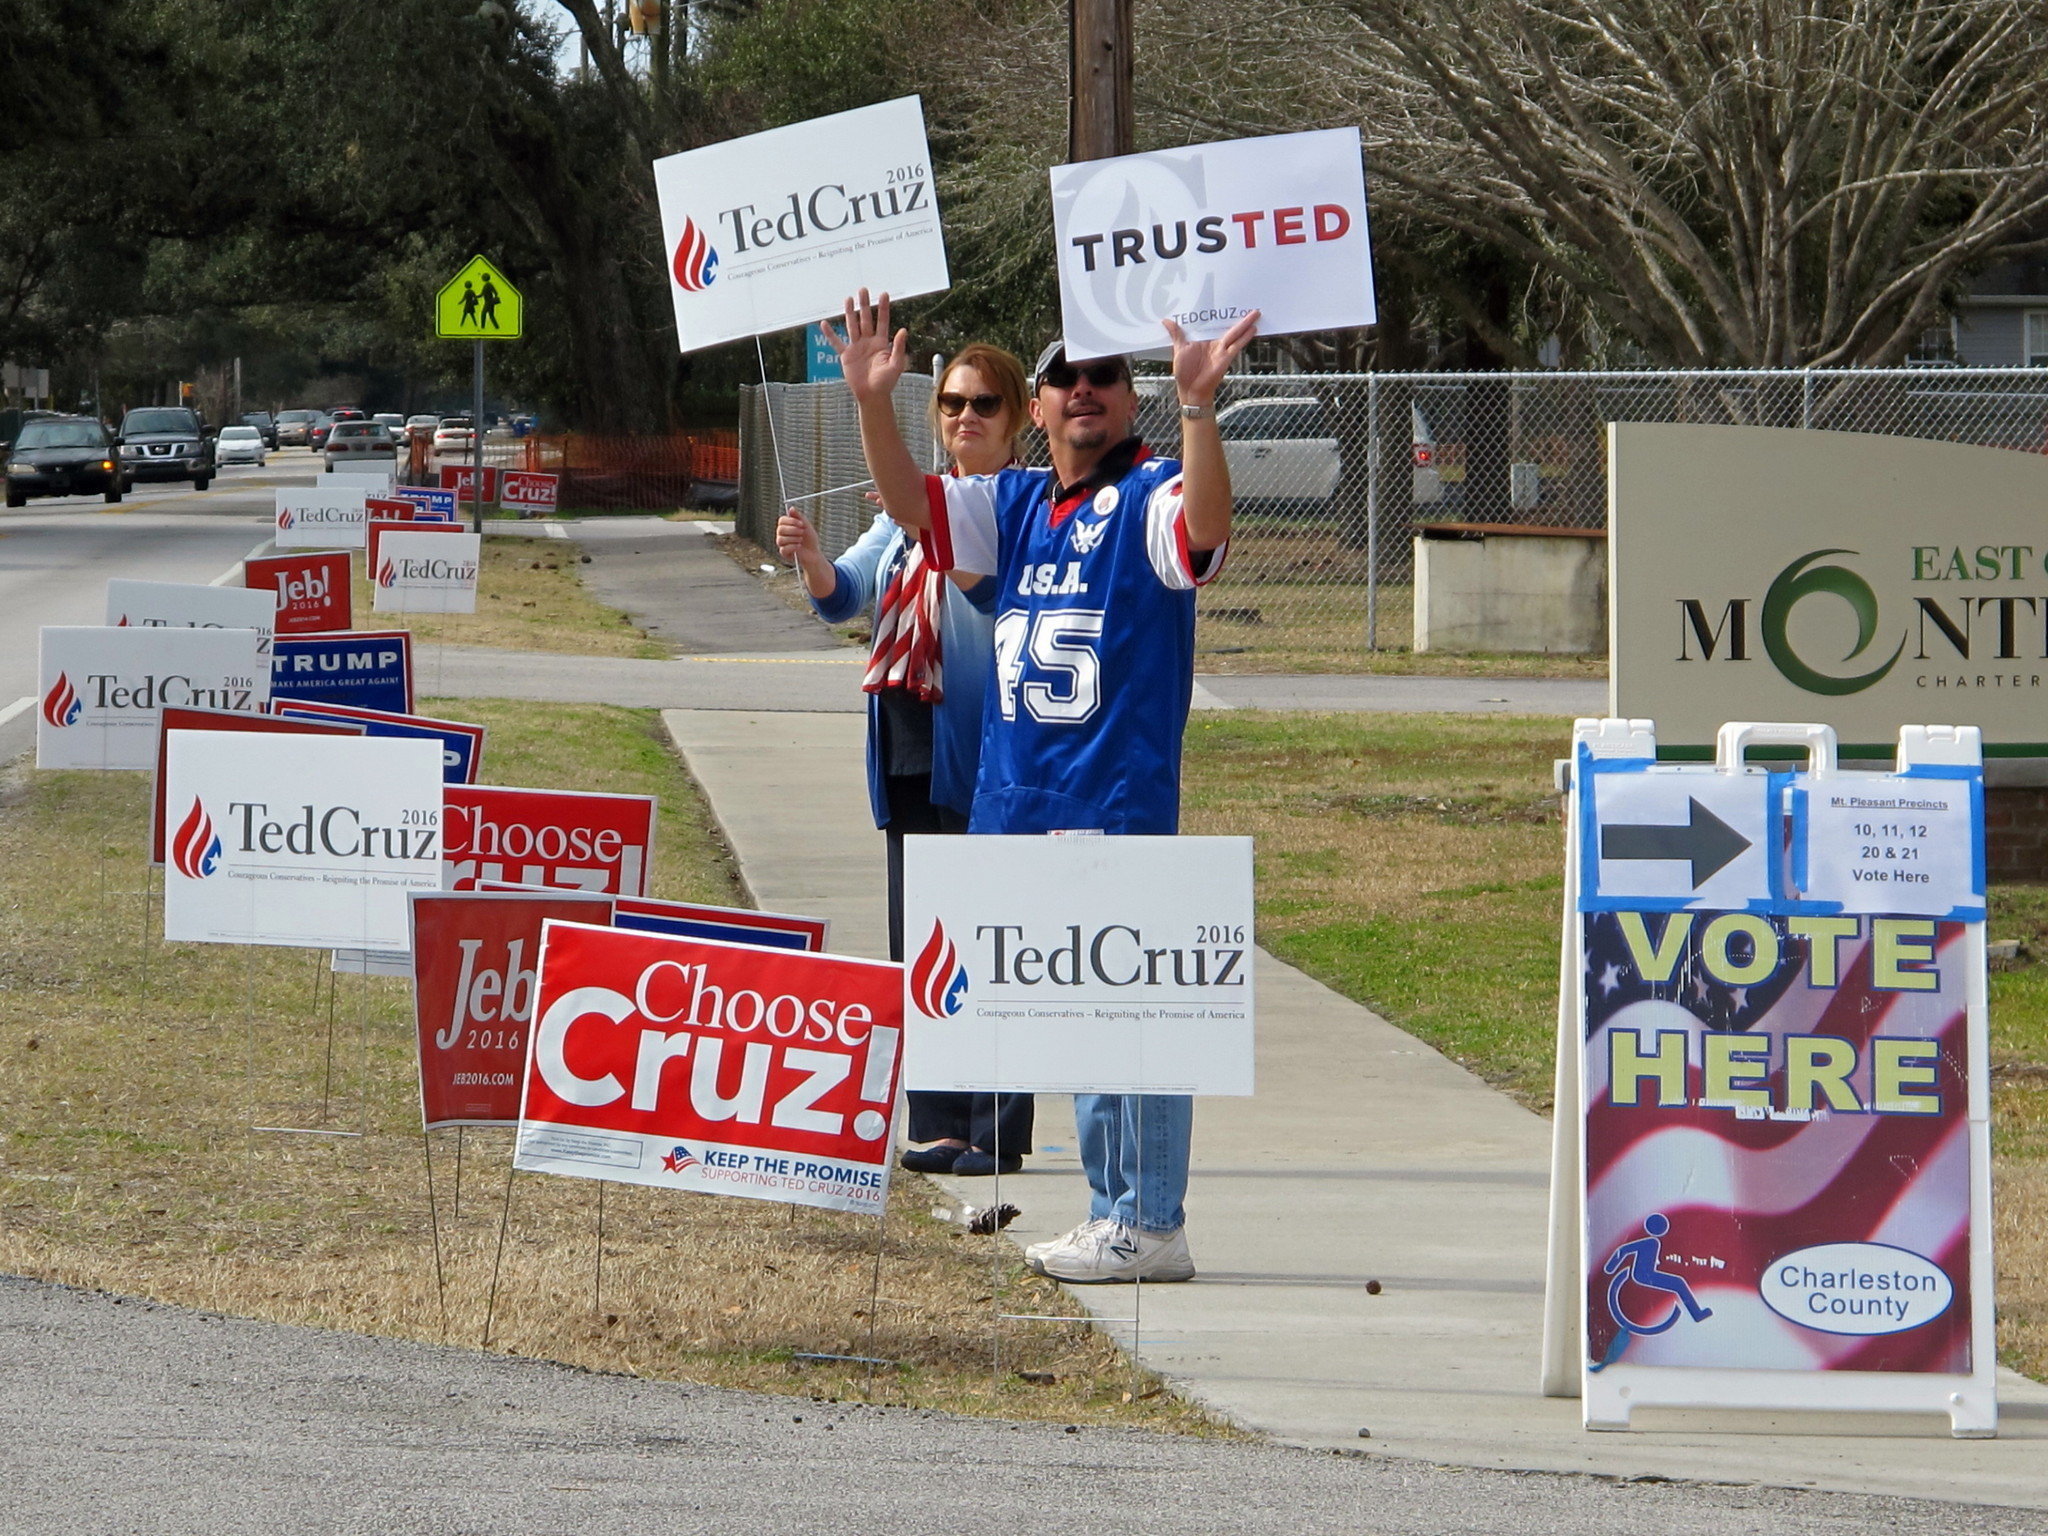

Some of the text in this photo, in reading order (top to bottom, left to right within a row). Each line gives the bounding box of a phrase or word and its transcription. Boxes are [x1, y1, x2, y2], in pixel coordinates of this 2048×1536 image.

[886, 163, 924, 184] 2016
[854, 242, 866, 250] the
[867, 235, 894, 248] Promise
[896, 232, 905, 240] of
[905, 228, 933, 239] America
[1072, 203, 1351, 273] TRUSTED
[1172, 307, 1260, 325] TEDCRUZ.o
[503, 481, 557, 502] Cruz!
[1911, 546, 2033, 581] EAST
[275, 565, 331, 611] Jeb!
[1017, 561, 1088, 596] US.A.
[292, 601, 320, 610] 2016
[273, 651, 398, 672] TRUMP
[994, 608, 1105, 724] 45
[224, 676, 252, 687] 2016
[271, 680, 294, 688] MAKE
[297, 679, 337, 687] AMERICA
[338, 678, 366, 686] GREAT
[1917, 675, 2041, 688] CHARTER
[1831, 797, 1948, 810] Mt. Pleasant Precincts
[402, 809, 438, 826] 2016
[443, 804, 622, 862] Choose
[1854, 824, 1928, 839] 10, 11, 12
[1862, 845, 1919, 860] 20 & 21
[228, 870, 268, 882] Courageous
[269, 871, 315, 882] Conservatives
[322, 875, 358, 886] Reigniting
[359, 875, 371, 884] the
[372, 877, 399, 886] Promise
[400, 878, 408, 886] of
[409, 879, 437, 888] America
[1852, 869, 1930, 883] Vote Here
[1196, 925, 1245, 944] 2016
[1617, 911, 1941, 994] VOTE
[635, 960, 872, 1046] Choose
[976, 1008, 1025, 1020] Courageous
[1028, 1008, 1085, 1019] Conservatives
[1094, 1008, 1140, 1020] Reigniting
[1142, 1009, 1157, 1019] the
[1159, 1009, 1194, 1019] Promise
[1196, 1009, 1206, 1019] of
[1207, 1010, 1245, 1019] America
[467, 1030, 519, 1050] 2016
[535, 986, 900, 1142] Cruz!
[1607, 1027, 1945, 1117] HERE
[453, 1072, 514, 1086] JEB2016.COM
[705, 1150, 882, 1188] KEEP THE PROMISE
[701, 1167, 880, 1201] SUPPORTING TED CRUZ 2016
[1780, 1266, 1937, 1292] Charleston
[1808, 1292, 1910, 1321] County
